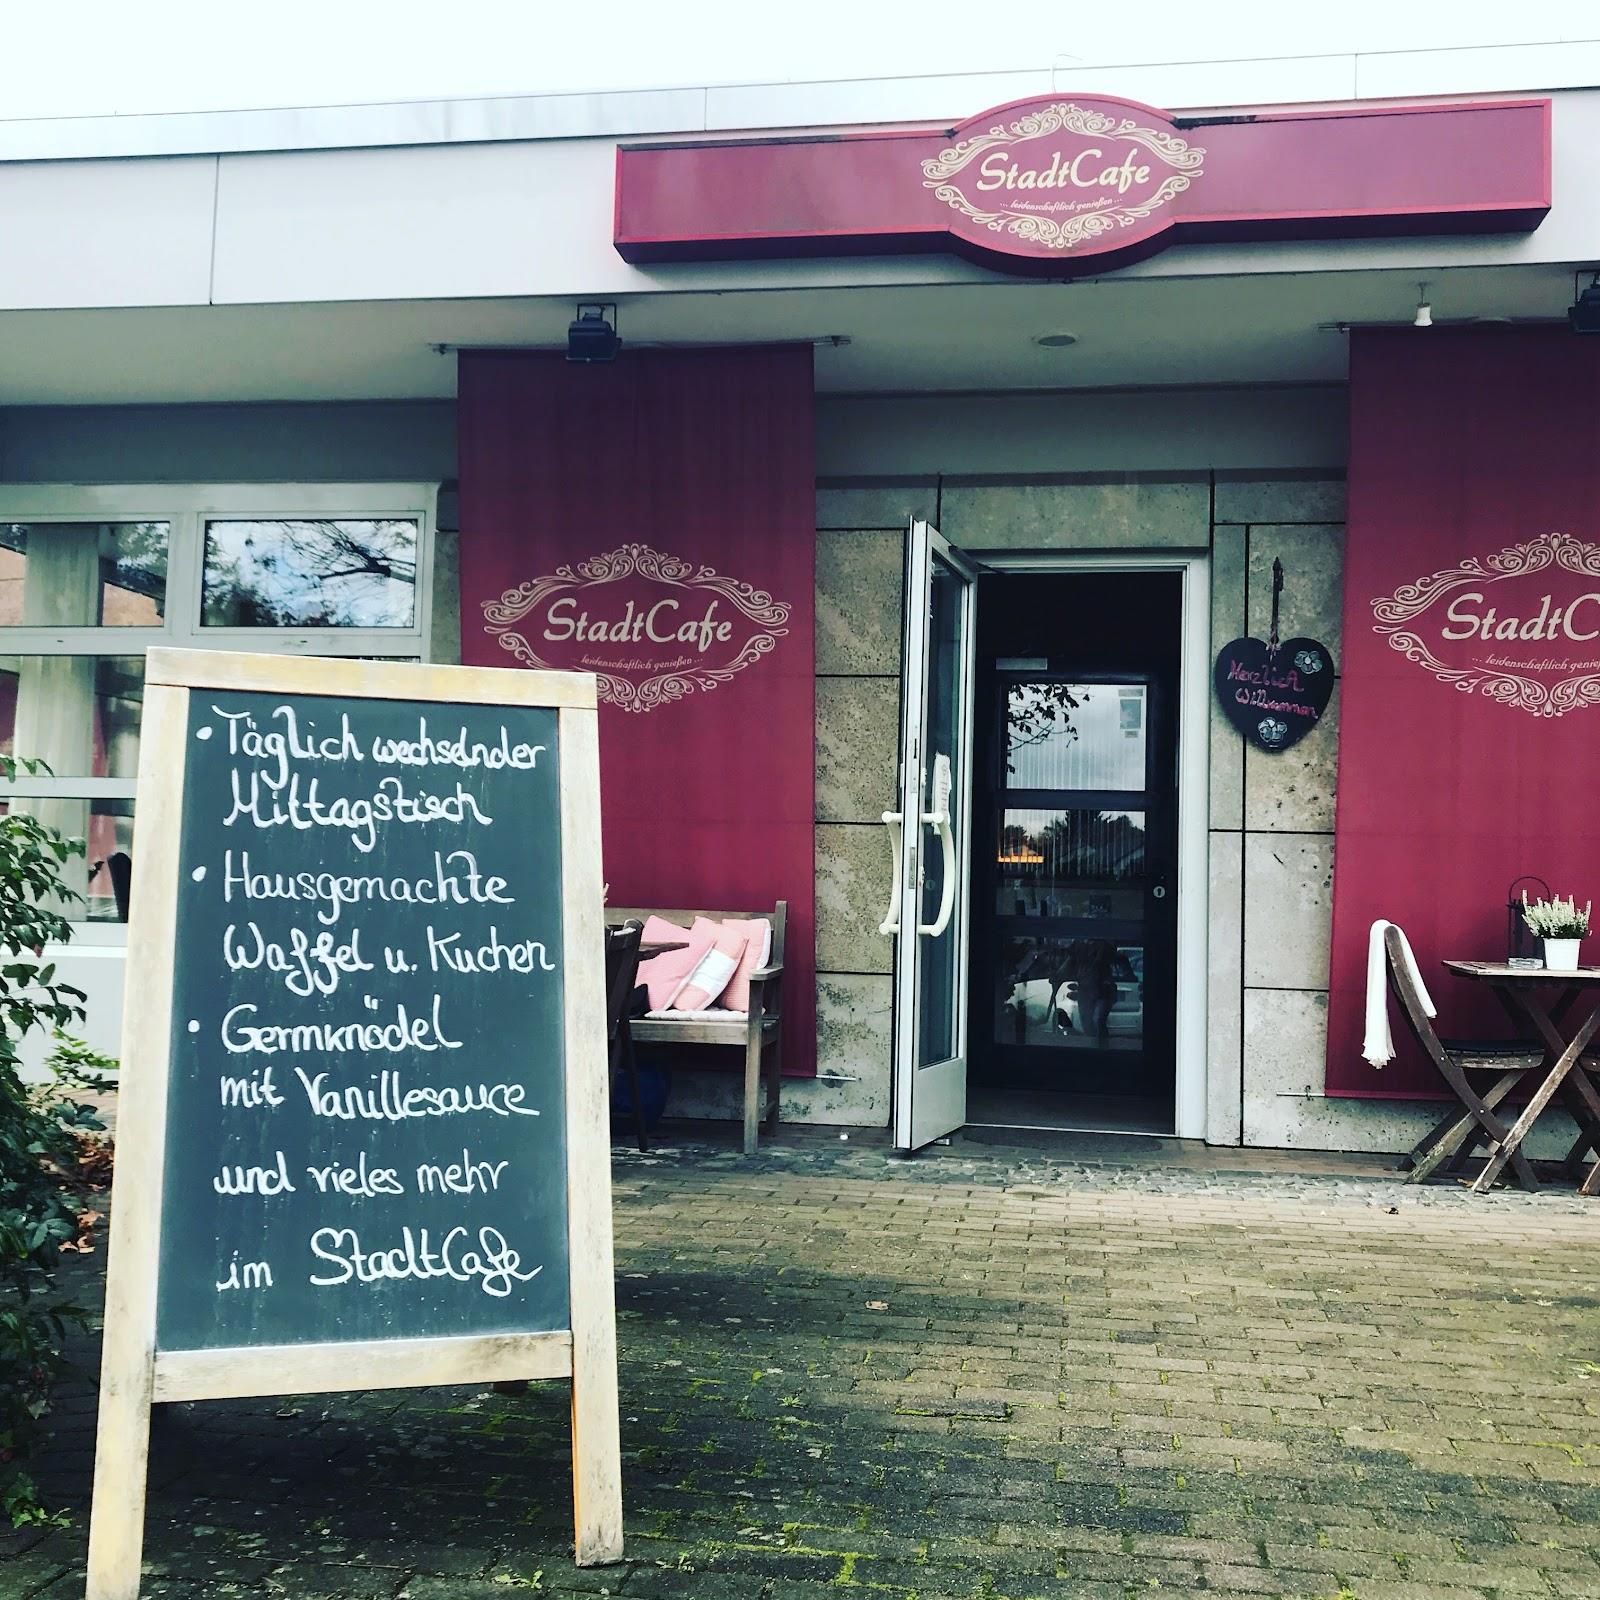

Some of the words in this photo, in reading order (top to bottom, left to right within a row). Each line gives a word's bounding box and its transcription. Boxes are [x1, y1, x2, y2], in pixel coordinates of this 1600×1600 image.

[977, 148, 1150, 194] StadtCafe
[1010, 199, 1075, 214] leidenschaftlich
[1076, 197, 1113, 212] genießen
[543, 598, 732, 653] StadtCafe
[580, 654, 652, 672] leidenschaftlich
[1485, 653, 1569, 672] leidenschaftlich
[212, 704, 364, 788] Täglich
[223, 768, 493, 852] Mittagstisch
[223, 849, 515, 925] Hausgemachte
[223, 922, 374, 996] Waffel
[426, 925, 556, 973] Kuchen
[220, 994, 464, 1053] Germknödel
[220, 1066, 286, 1109] mit
[294, 1066, 540, 1121] Vanillesauce
[213, 1151, 296, 1195] und
[306, 1151, 404, 1198] vieles
[416, 1148, 509, 1194] mehr
[215, 1250, 273, 1291] im
[309, 1226, 543, 1297] StadtCafe
